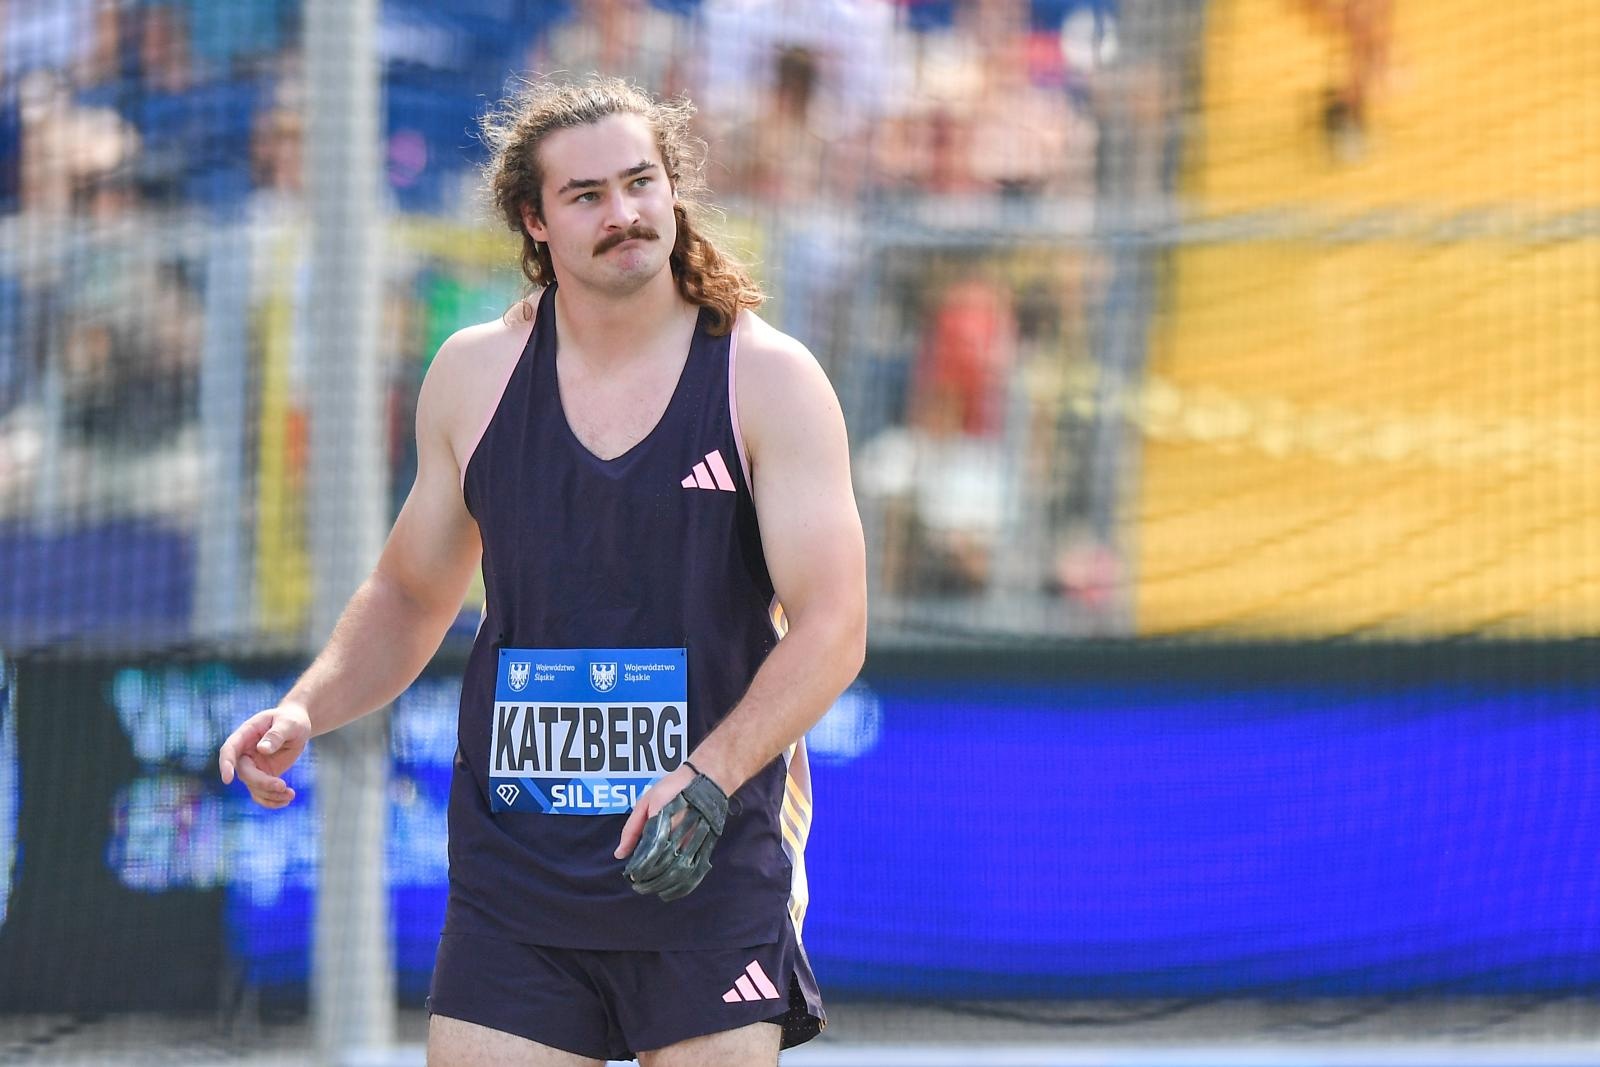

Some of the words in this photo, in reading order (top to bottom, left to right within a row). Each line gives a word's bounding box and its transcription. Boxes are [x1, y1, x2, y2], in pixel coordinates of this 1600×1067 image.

[624, 663, 676, 672] Województwo
[495, 705, 682, 772] KATZBERG
[551, 784, 652, 808] SILESI
